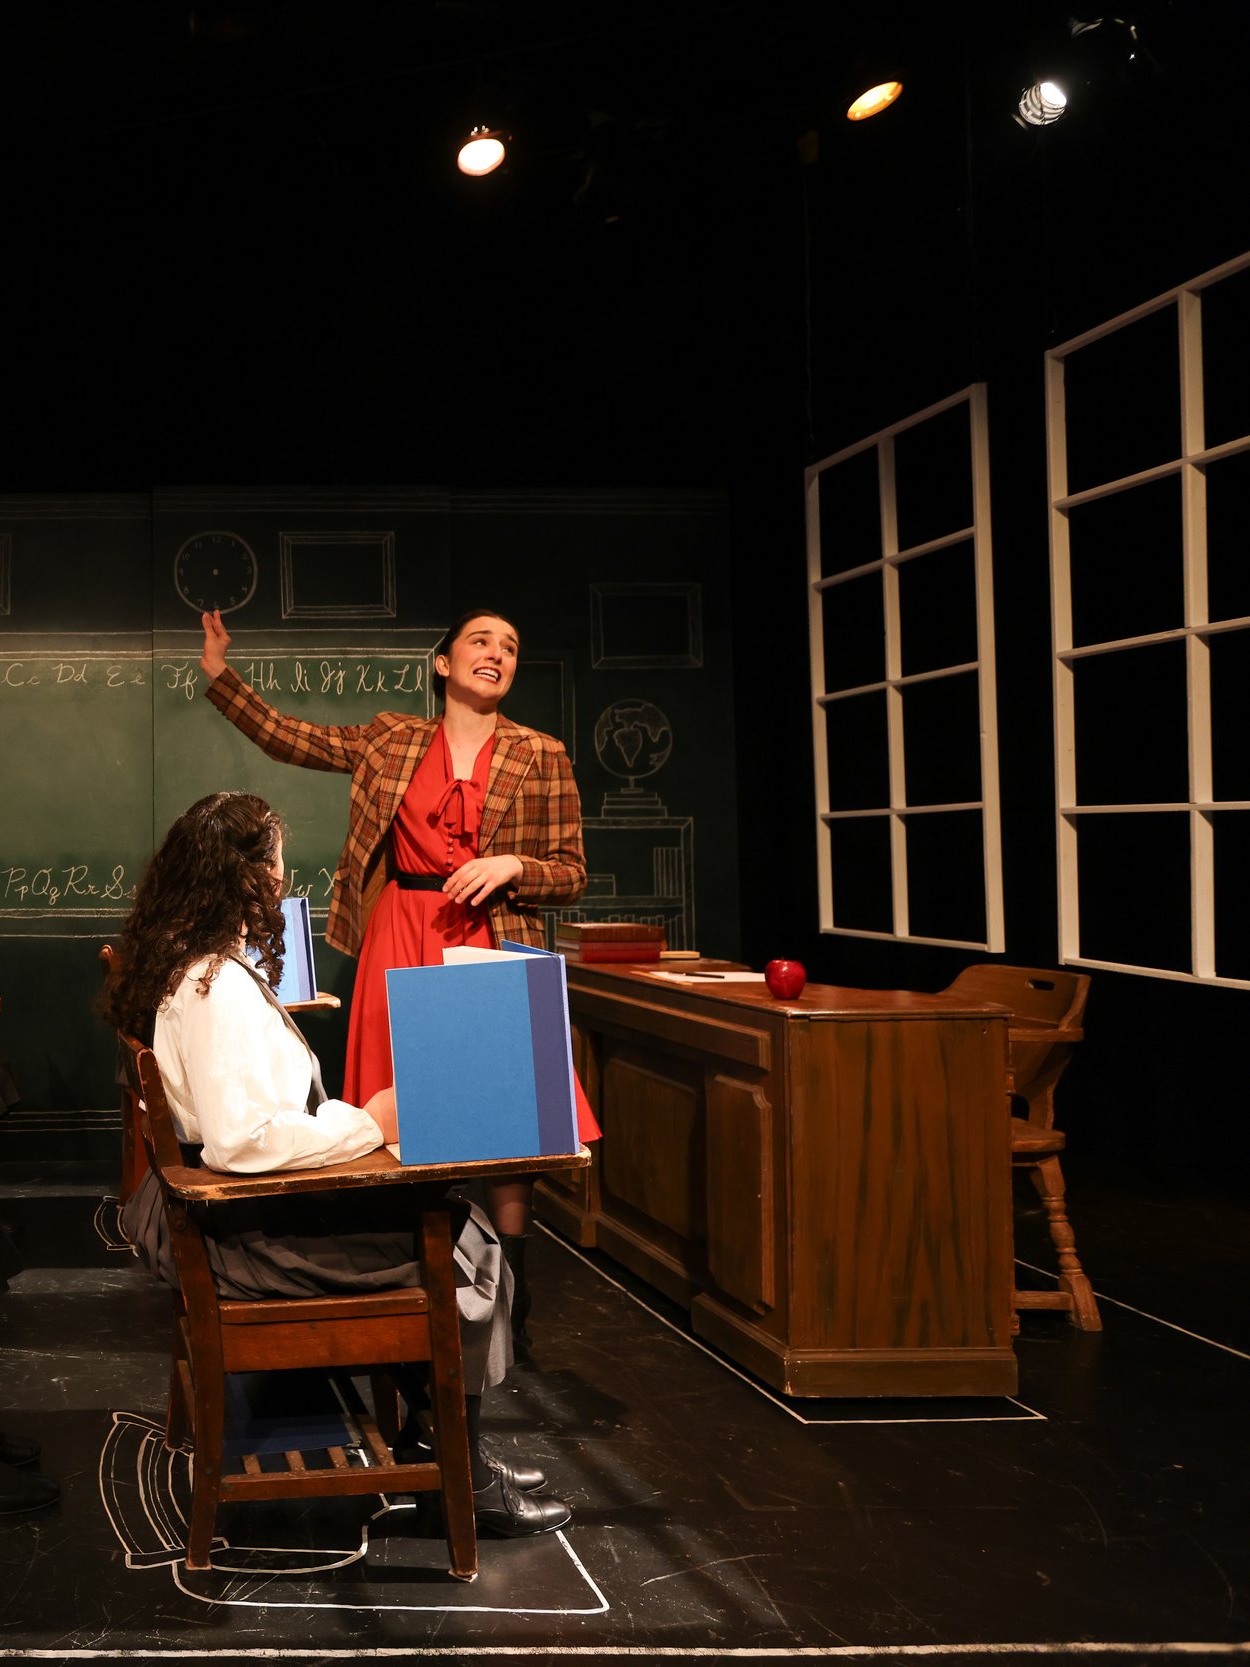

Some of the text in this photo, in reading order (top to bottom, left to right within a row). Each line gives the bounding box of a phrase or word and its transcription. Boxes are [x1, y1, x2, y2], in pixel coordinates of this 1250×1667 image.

[1, 662, 41, 688] Cc
[51, 663, 89, 684] Dd
[106, 665, 146, 688] Ee
[160, 661, 199, 701] Ff
[244, 661, 282, 692] Hh
[319, 660, 347, 695] Jj
[356, 664, 389, 694] Kk
[393, 663, 425, 693] Ll
[0, 866, 31, 902] Pp
[31, 867, 61, 906] Qq
[61, 864, 100, 897] Rr
